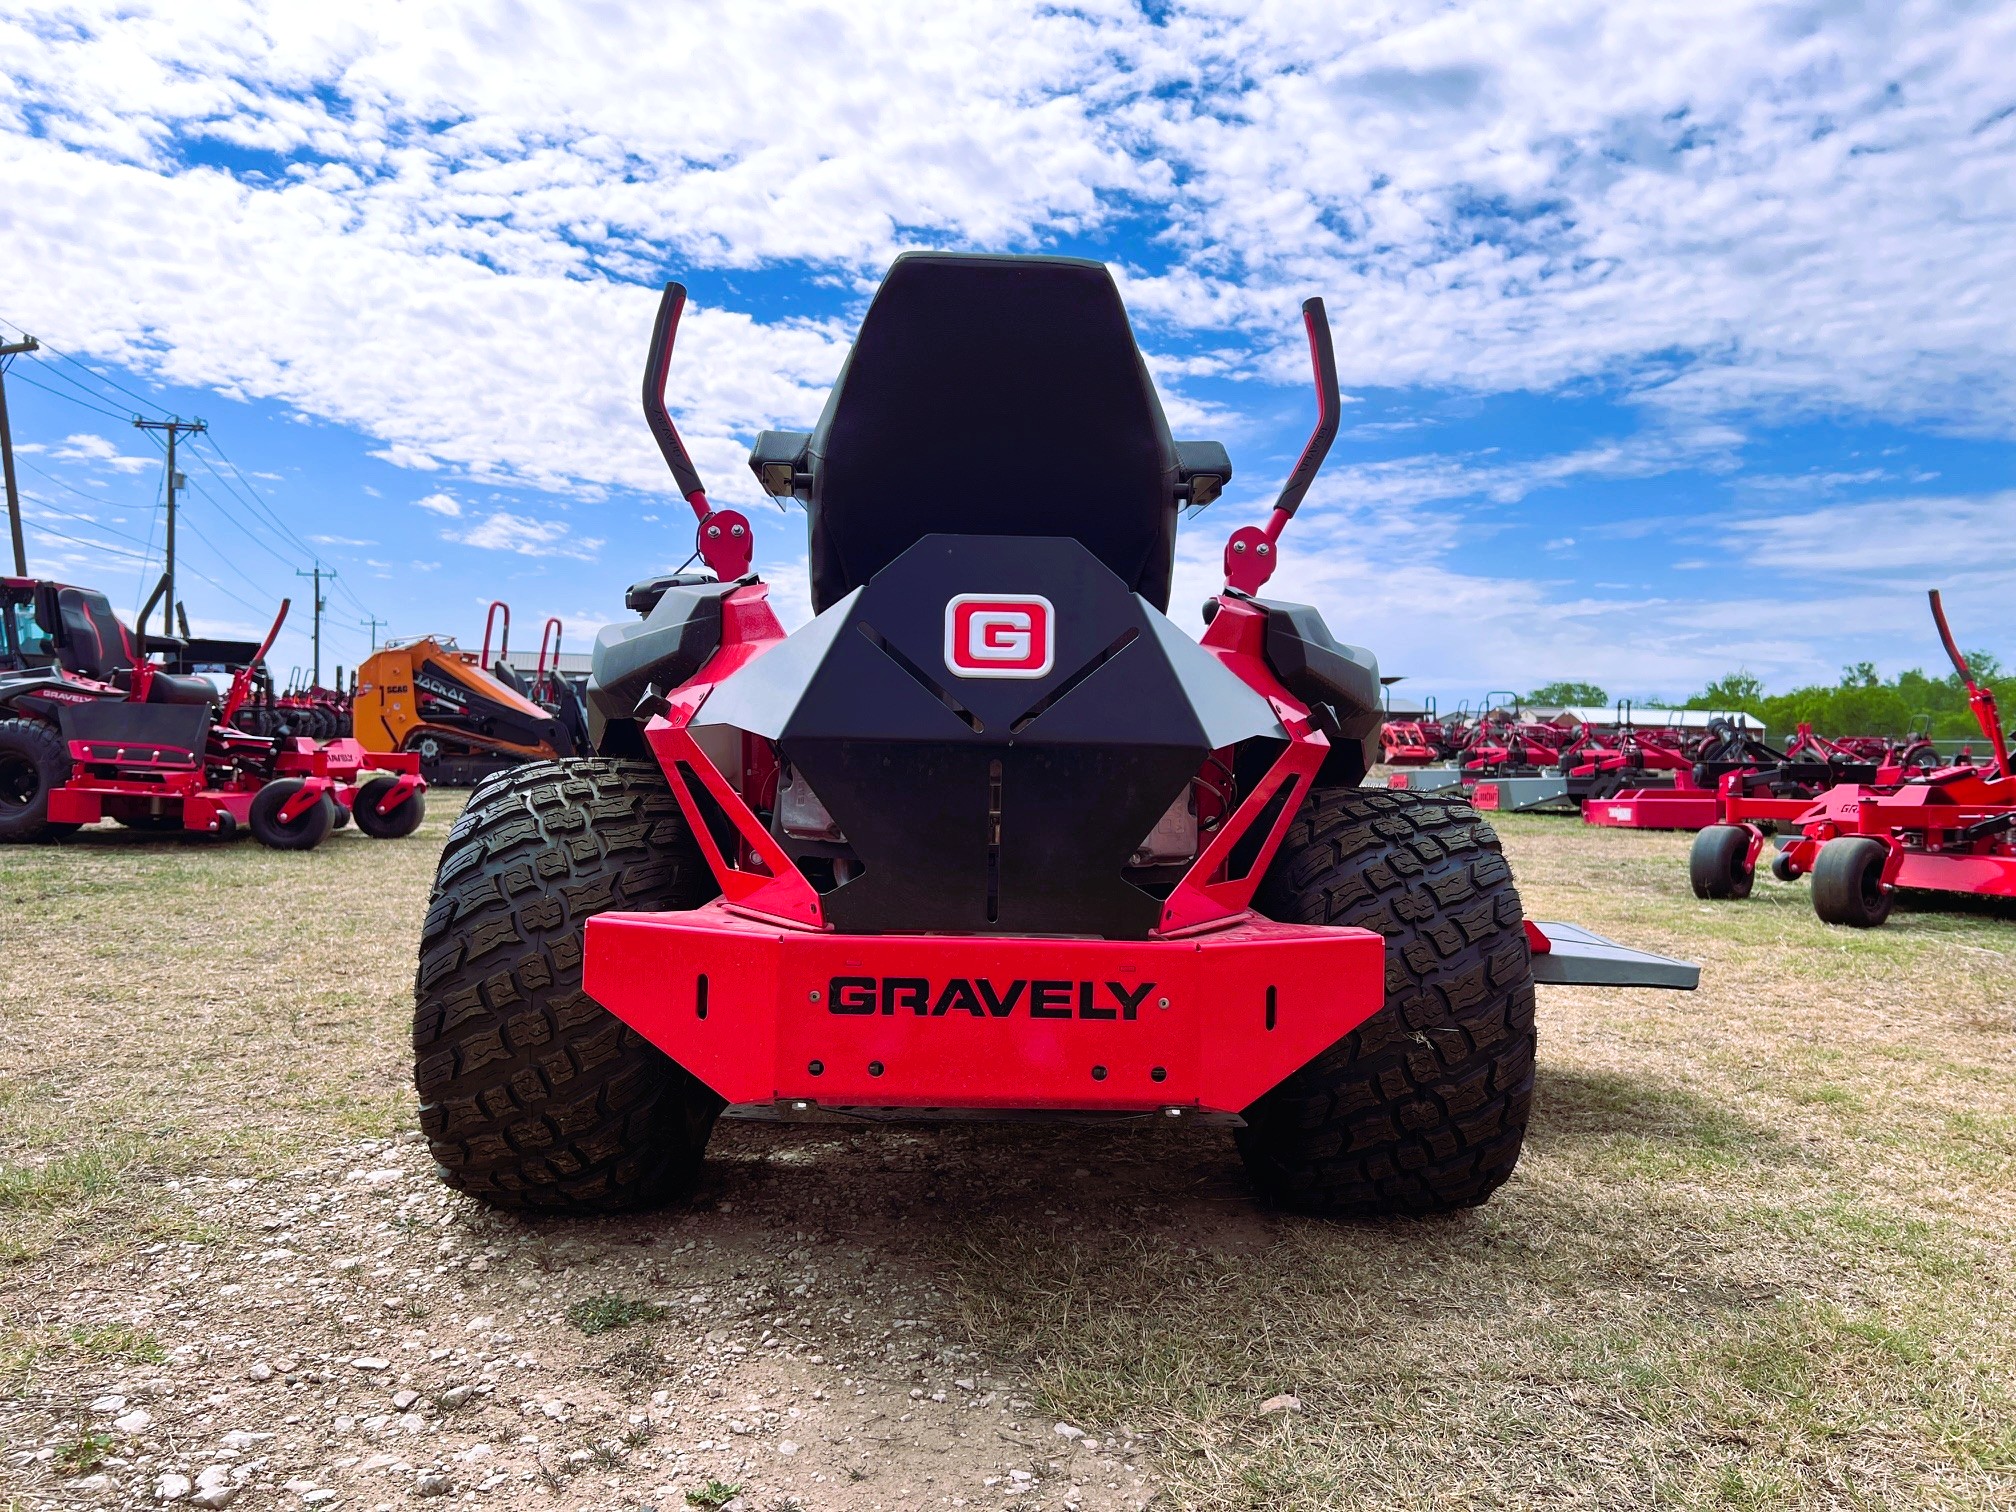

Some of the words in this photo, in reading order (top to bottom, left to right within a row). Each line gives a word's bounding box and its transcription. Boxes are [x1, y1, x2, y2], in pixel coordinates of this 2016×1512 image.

[968, 610, 1032, 661] G
[42, 689, 93, 703] GRAVELY
[414, 674, 467, 704] JACKAL
[828, 975, 1158, 1021] GRAVELY
